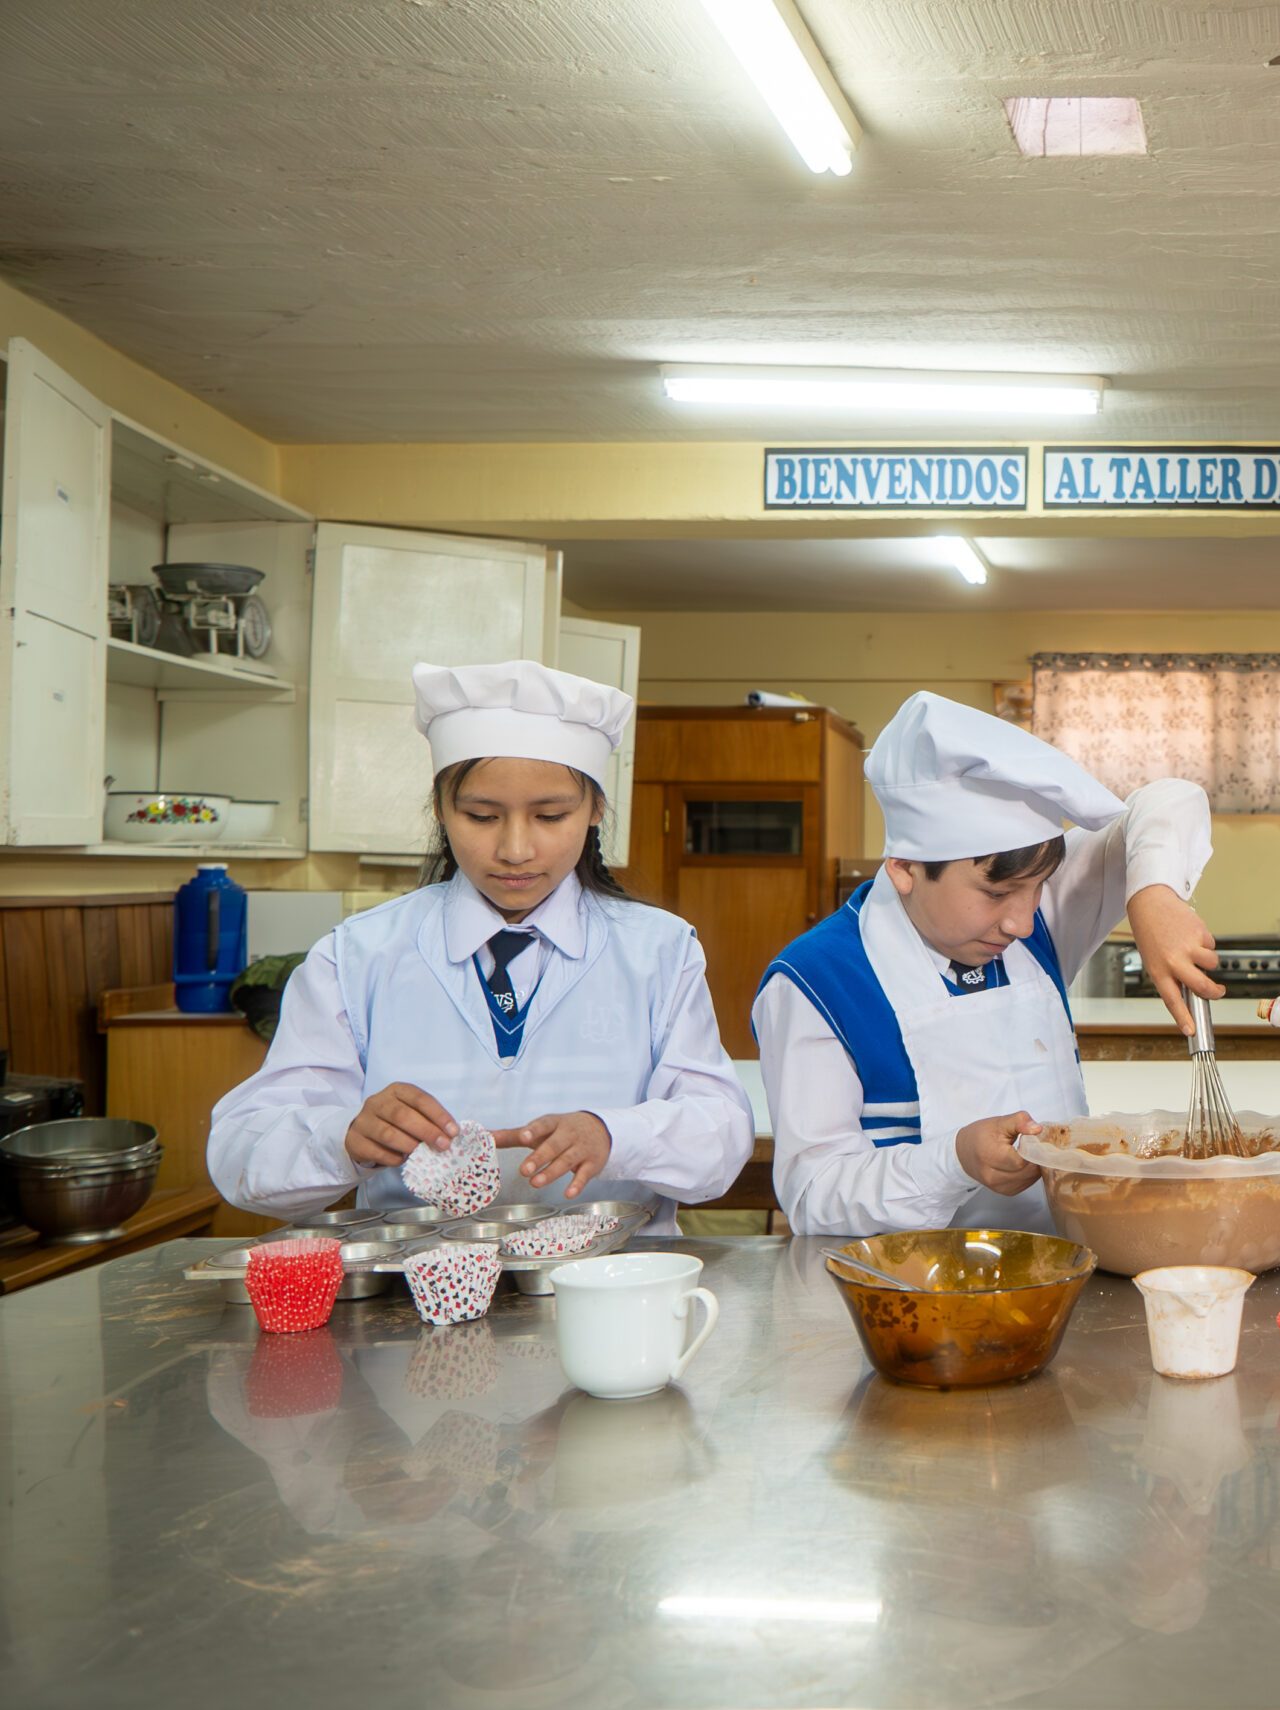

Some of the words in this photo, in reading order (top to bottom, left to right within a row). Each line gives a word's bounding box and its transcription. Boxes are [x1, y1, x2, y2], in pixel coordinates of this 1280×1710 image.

[775, 457, 1021, 501] BIENVENIDOS
[1054, 457, 1101, 499] AL
[1109, 457, 1244, 500] TALLER
[490, 991, 514, 1008] VS
